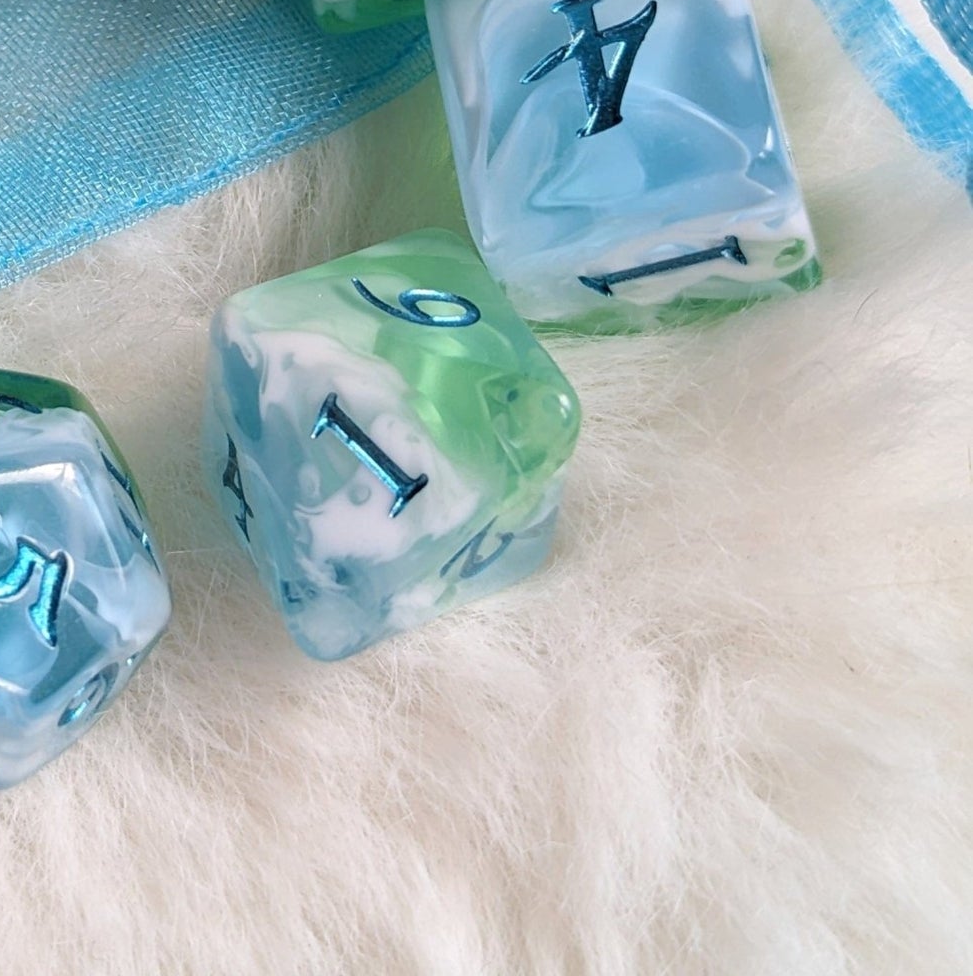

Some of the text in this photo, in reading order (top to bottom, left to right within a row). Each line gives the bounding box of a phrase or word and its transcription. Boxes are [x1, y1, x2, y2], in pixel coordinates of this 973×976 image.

[578, 235, 748, 296] 1
[351, 277, 482, 328] 6
[310, 391, 429, 519] 1
